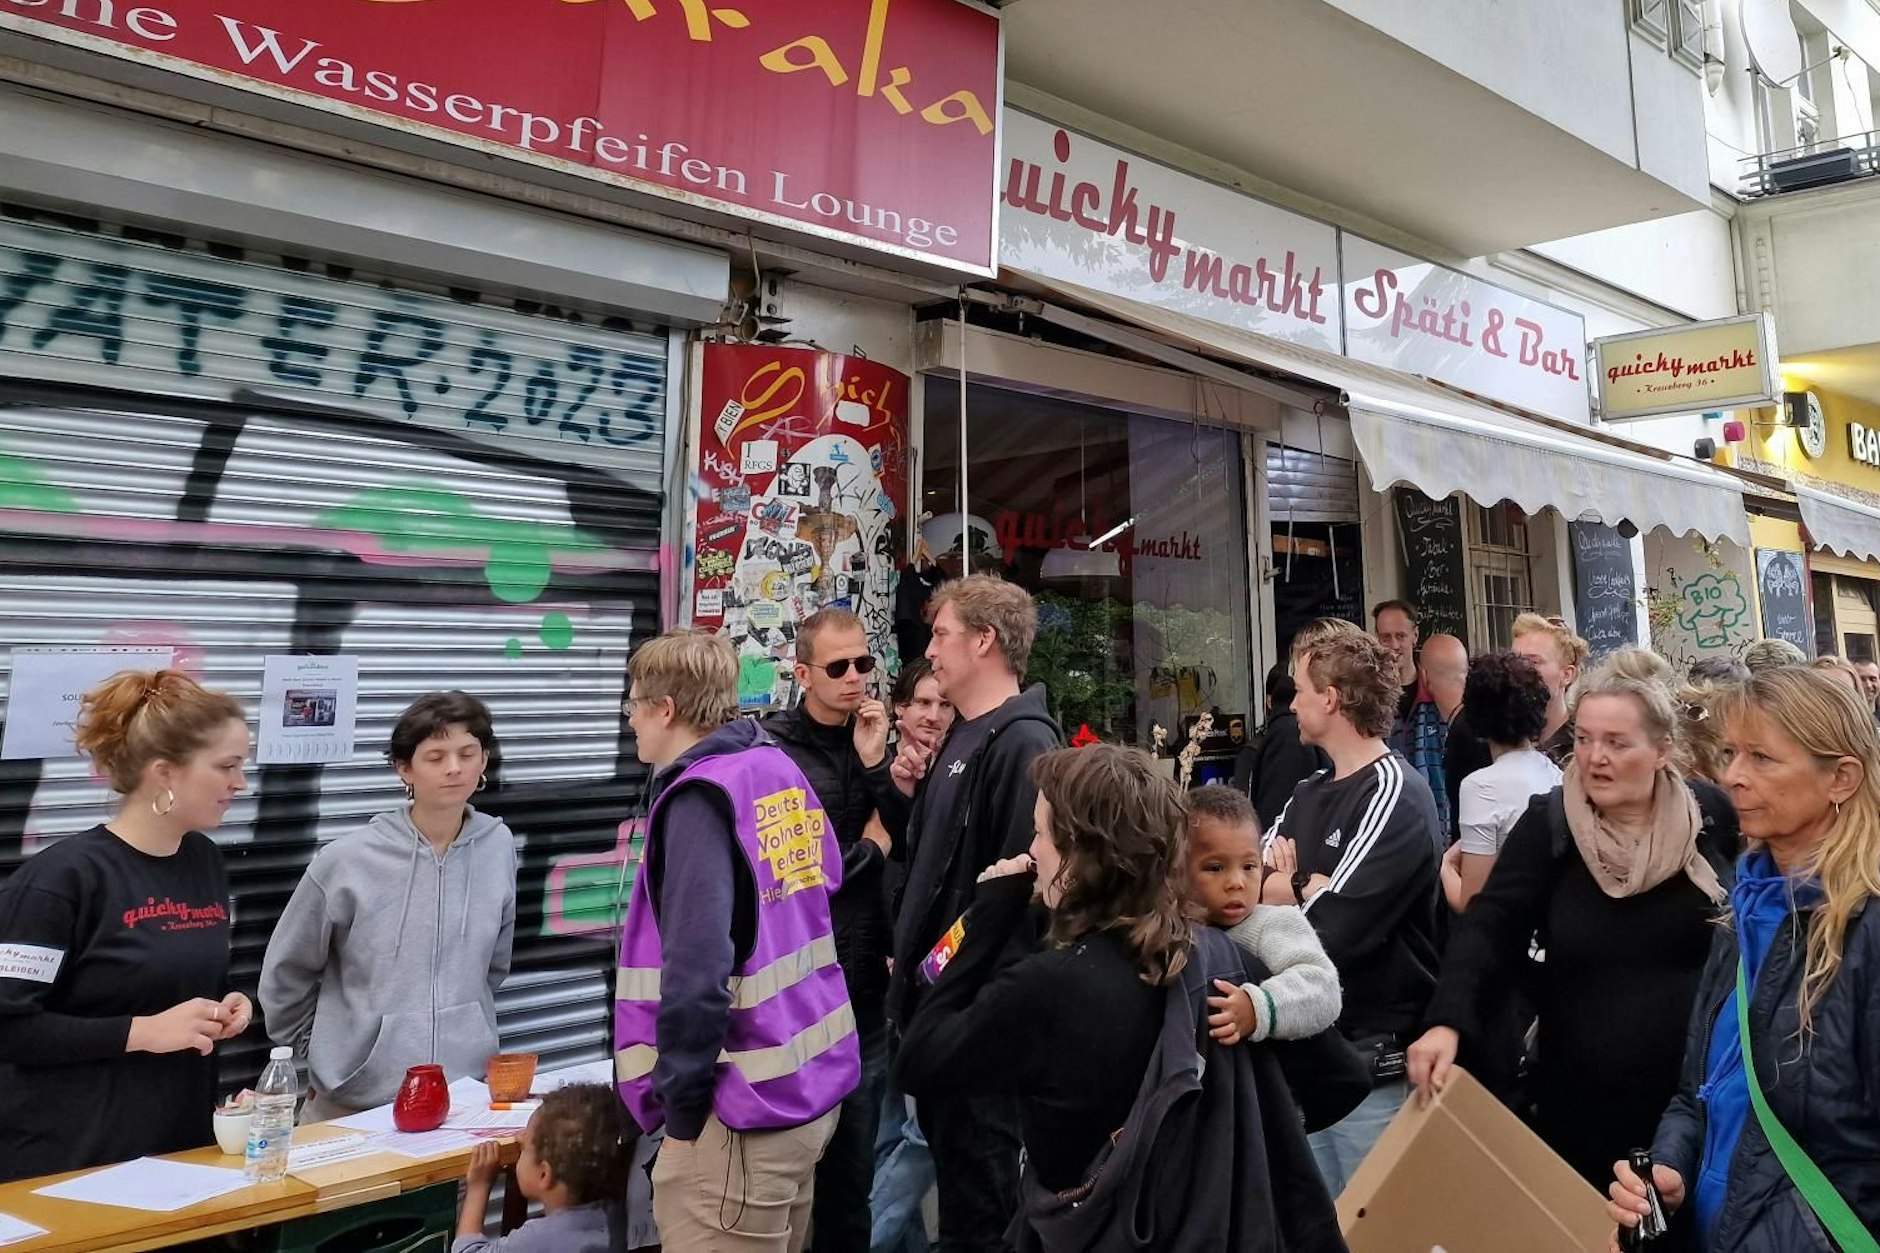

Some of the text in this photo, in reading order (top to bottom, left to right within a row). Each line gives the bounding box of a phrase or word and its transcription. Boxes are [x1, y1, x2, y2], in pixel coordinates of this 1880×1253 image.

[215, 13, 748, 196] Wasserpfeifen
[769, 170, 958, 248] Lounge
[1000, 129, 1182, 283] uicky
[1354, 269, 1580, 381] Späti & Bar
[1848, 420, 1880, 466] BA
[1690, 585, 1722, 605] BIO
